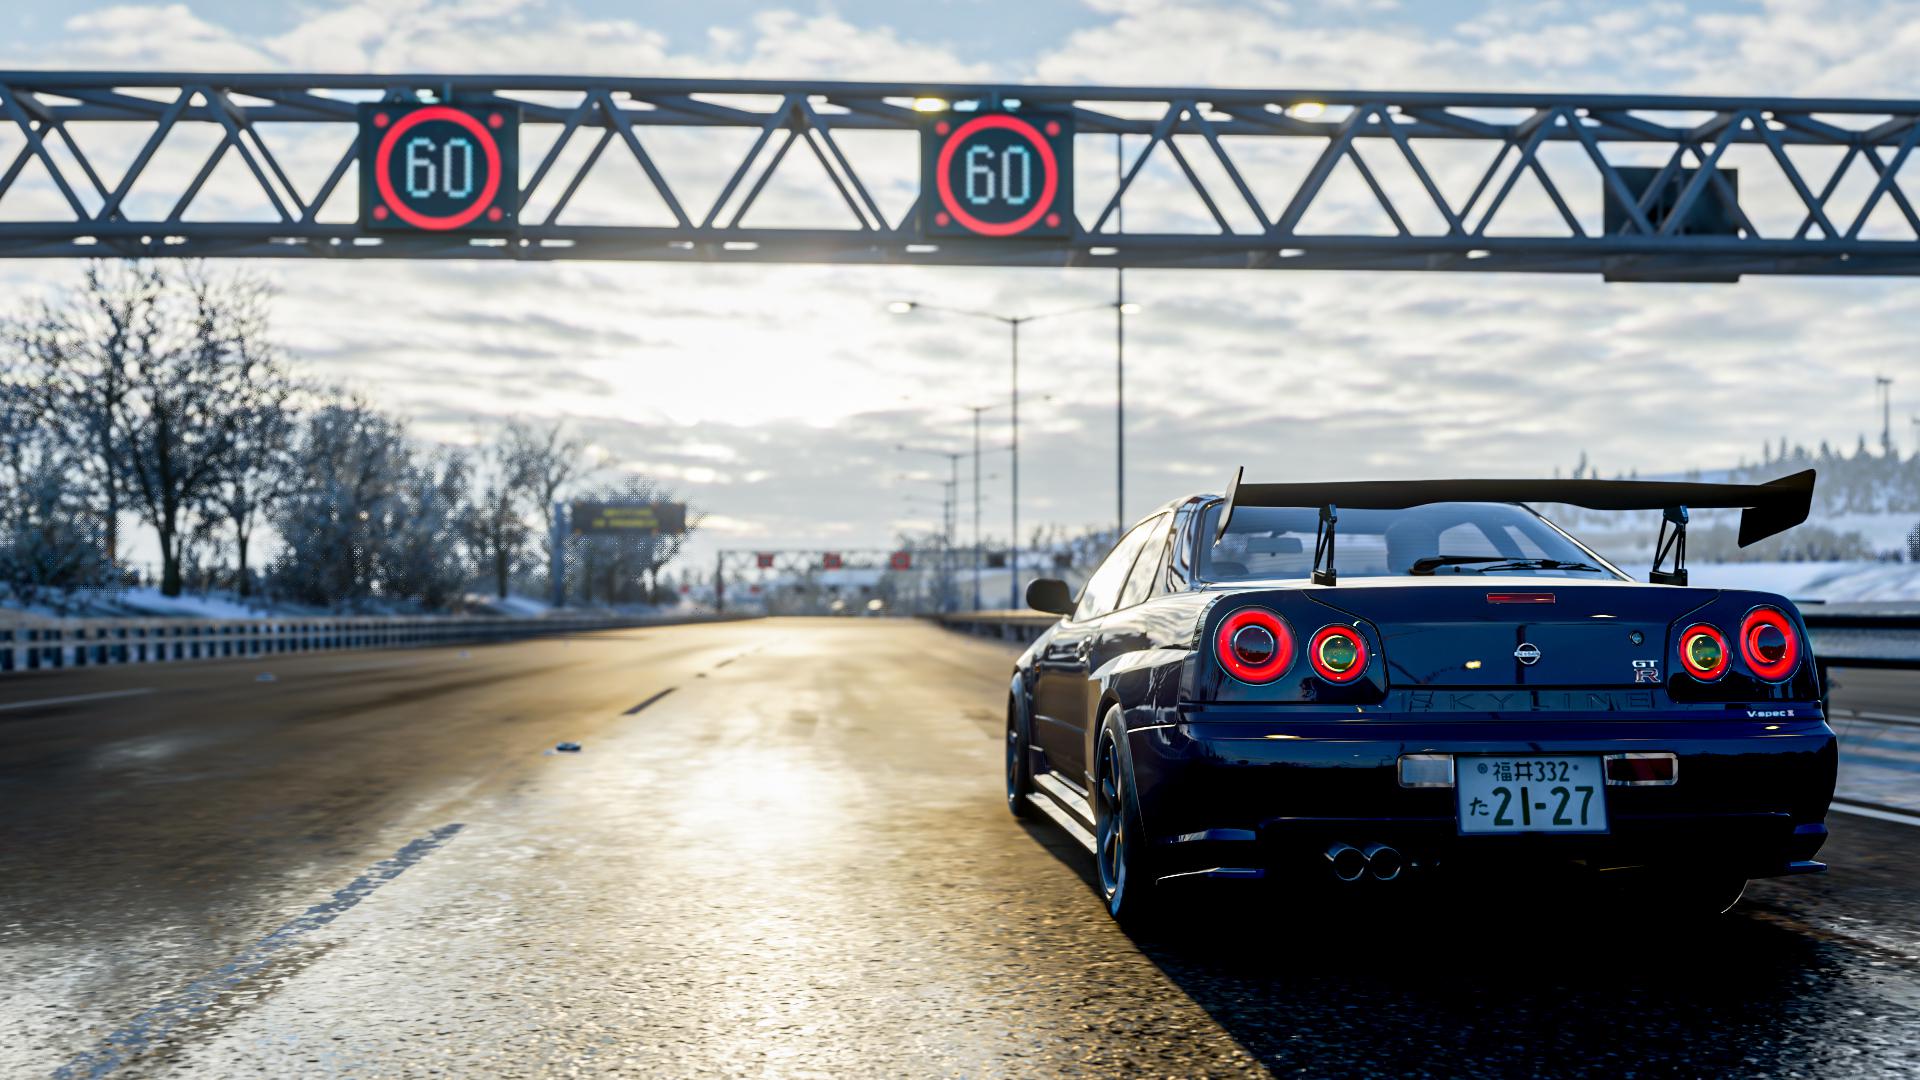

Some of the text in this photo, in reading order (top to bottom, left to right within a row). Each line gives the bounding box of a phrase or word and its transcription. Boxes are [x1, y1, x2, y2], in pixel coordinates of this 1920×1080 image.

[406, 138, 473, 198] 60
[966, 145, 1030, 205] 60
[1634, 668, 1660, 682] R
[1469, 786, 1594, 826] た 21-27
